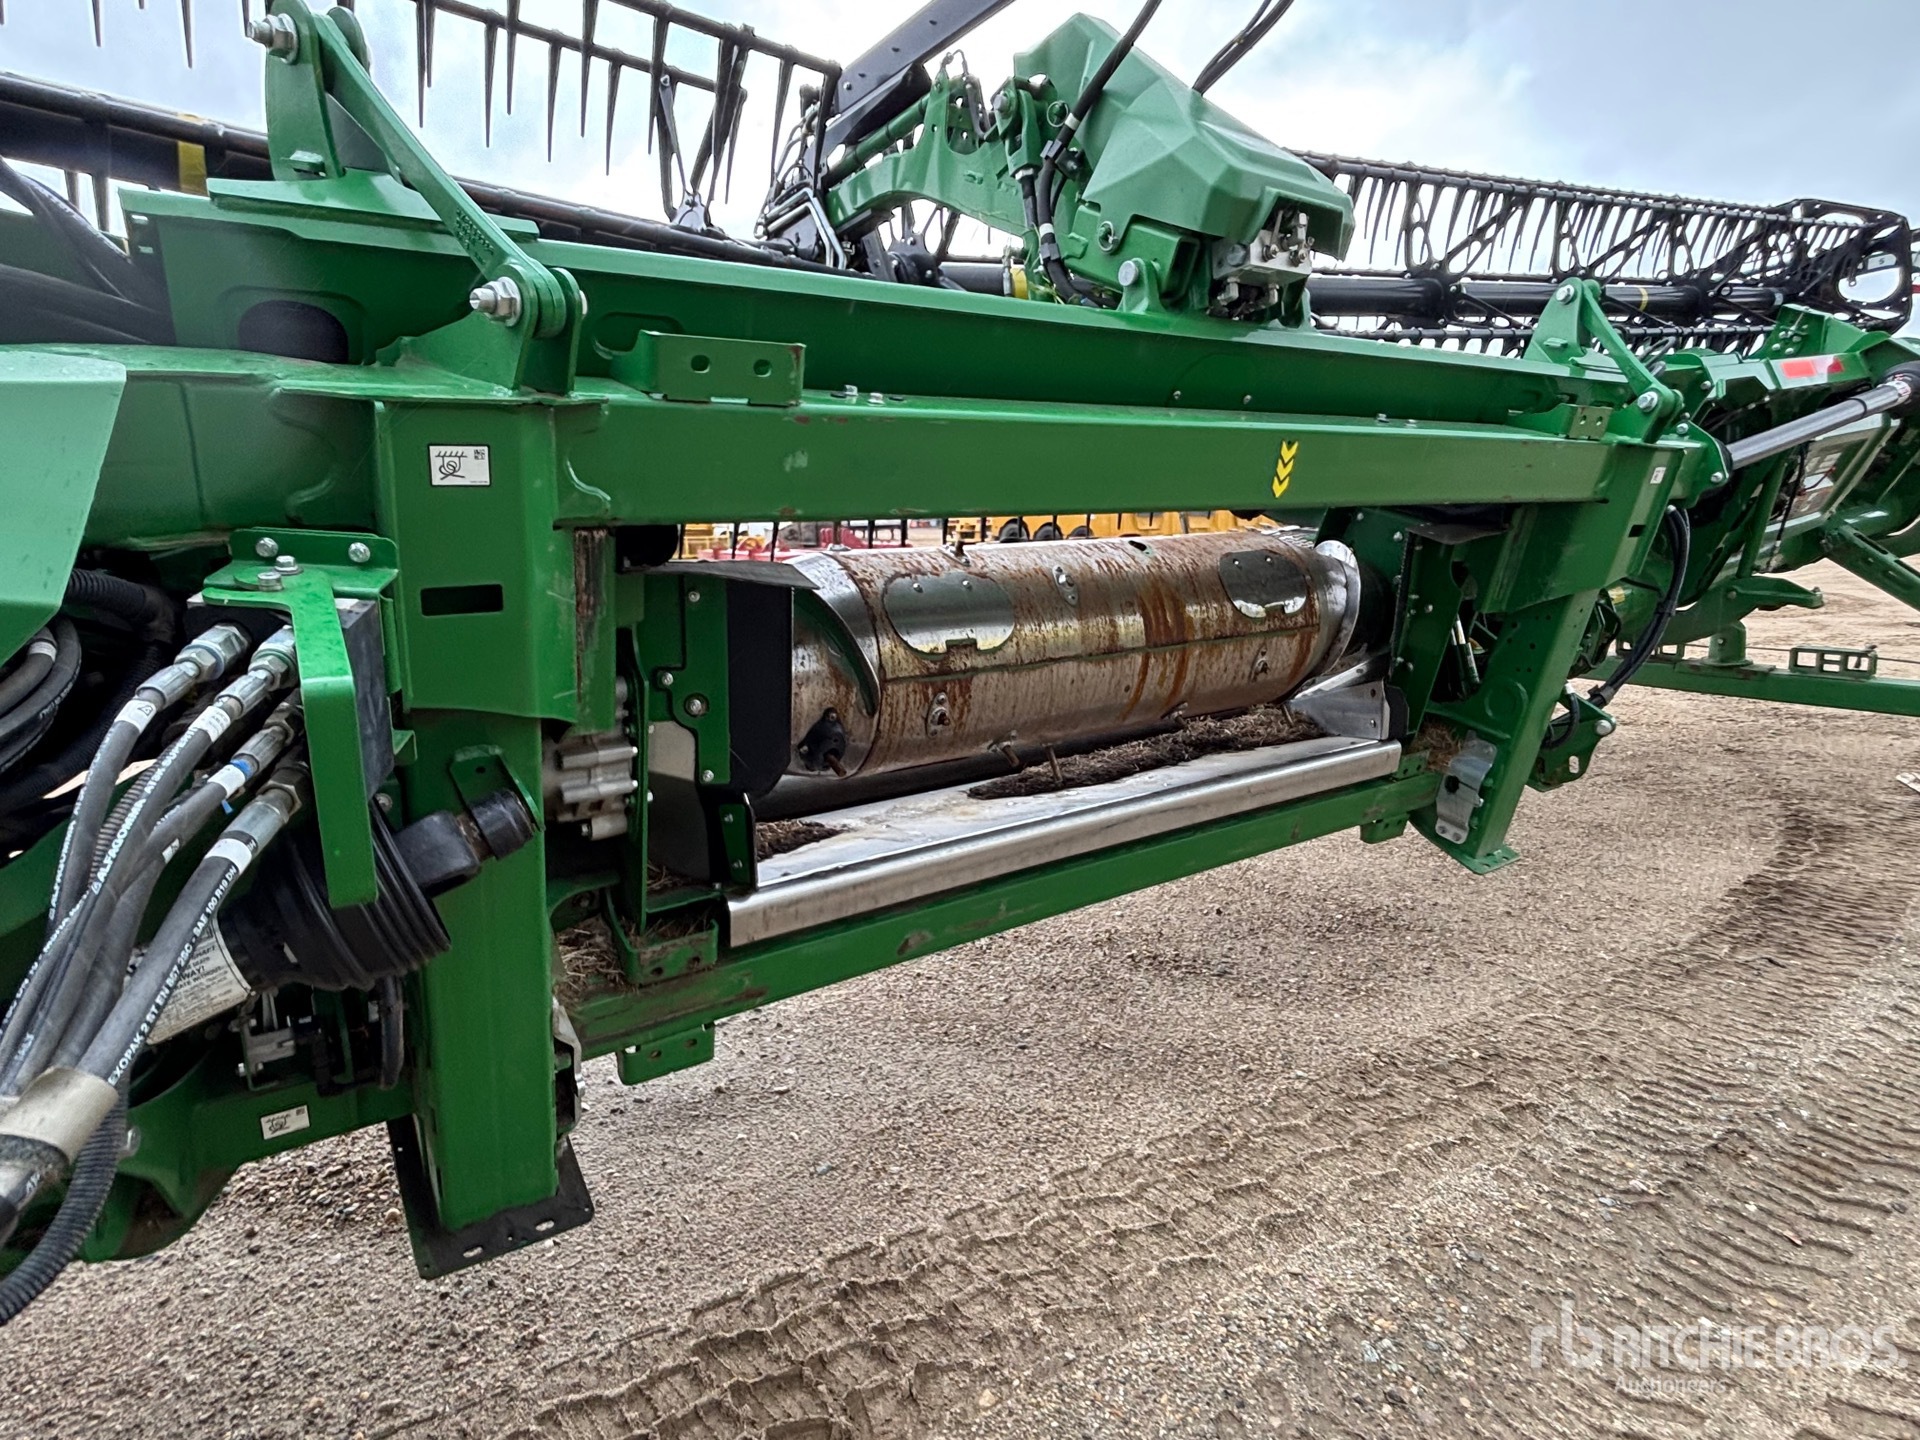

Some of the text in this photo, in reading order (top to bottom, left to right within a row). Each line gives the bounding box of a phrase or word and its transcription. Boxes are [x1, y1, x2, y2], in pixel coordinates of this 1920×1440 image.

[97, 798, 146, 883] ALFAGOMMA
[155, 985, 169, 1006] EN
[205, 897, 217, 914] 100
[225, 866, 237, 882] DN
